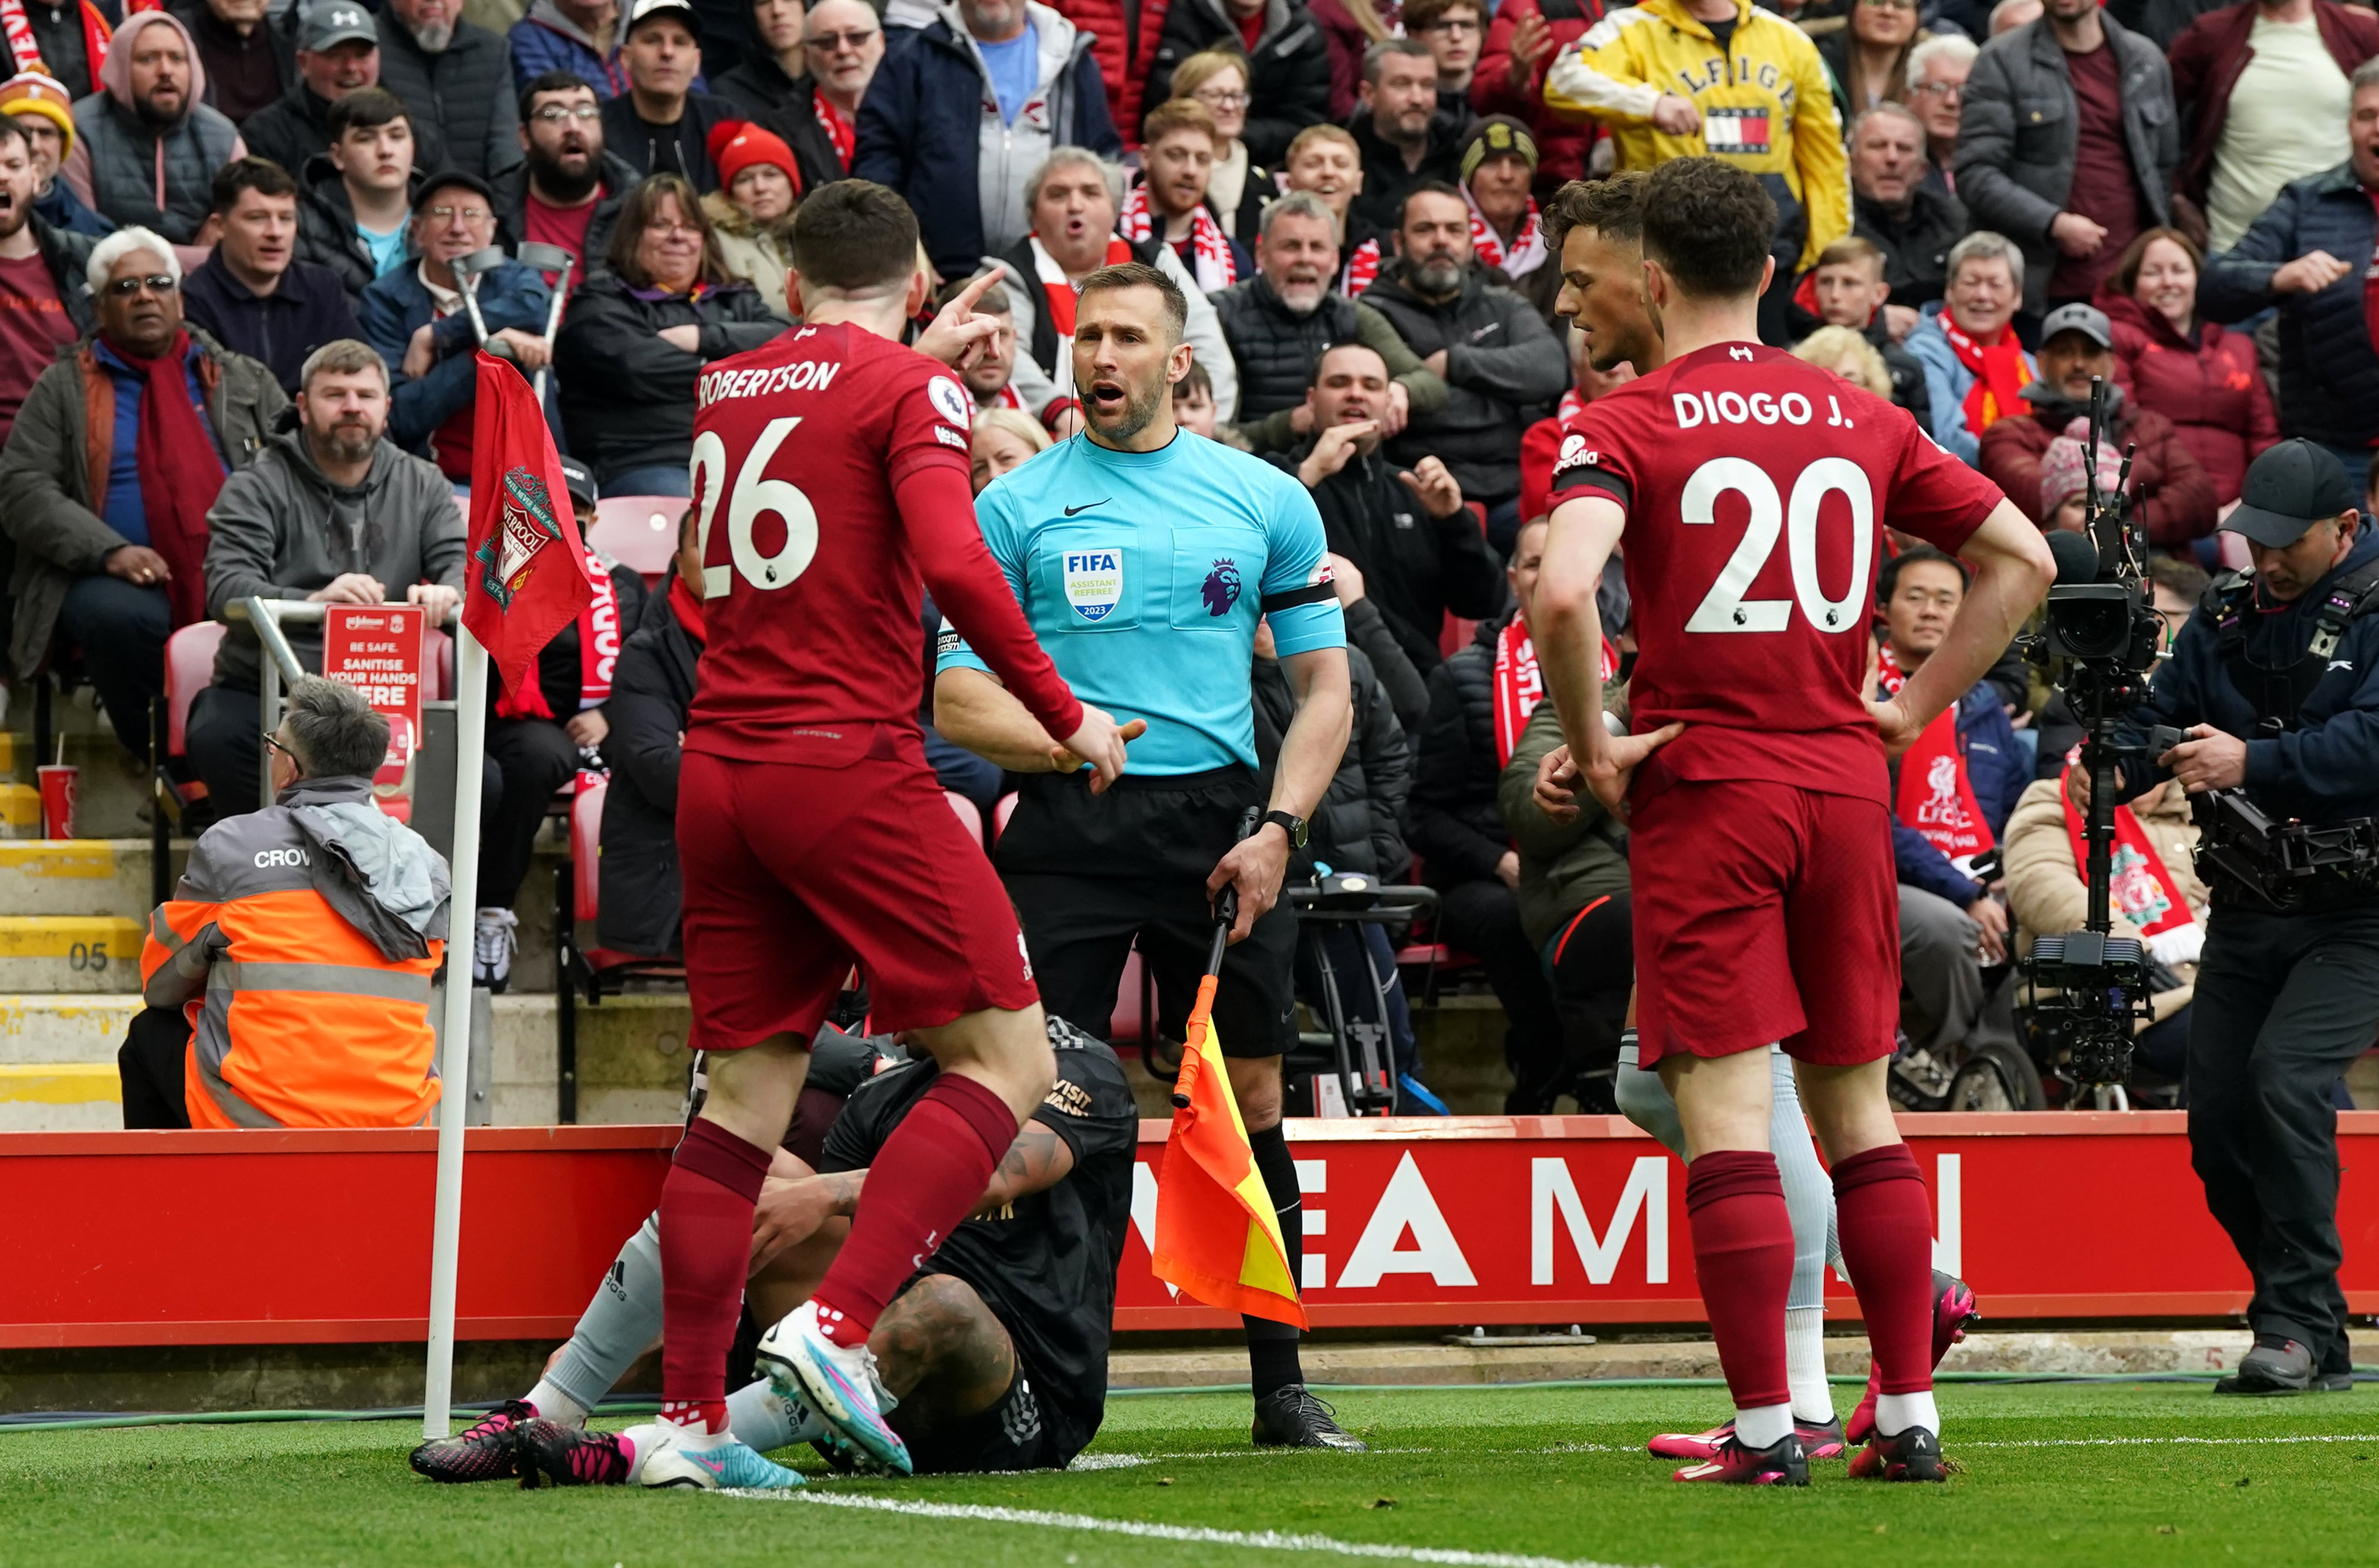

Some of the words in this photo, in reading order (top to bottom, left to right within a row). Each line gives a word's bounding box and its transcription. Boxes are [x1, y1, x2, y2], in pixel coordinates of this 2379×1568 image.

[699, 360, 840, 410] ROBERTSON
[1672, 391, 1813, 428] DIOGO
[1827, 395, 1854, 429] J.
[1552, 448, 1598, 476] pedia
[532, 504, 546, 521] WALK
[689, 416, 819, 599] 26
[1681, 456, 1874, 634] 20
[1069, 554, 1116, 572] FIFA
[1070, 579, 1117, 588] ASSISTANT
[1074, 587, 1113, 597] REFEREE
[1084, 606, 1106, 616] 2023
[349, 642, 365, 653] BE
[343, 658, 404, 671] SANITISE
[329, 671, 367, 684] YOUR
[370, 673, 417, 685] HANDS
[353, 685, 406, 706] ERE
[70, 942, 108, 972] 05
[1052, 1078, 1092, 1109] VISIT
